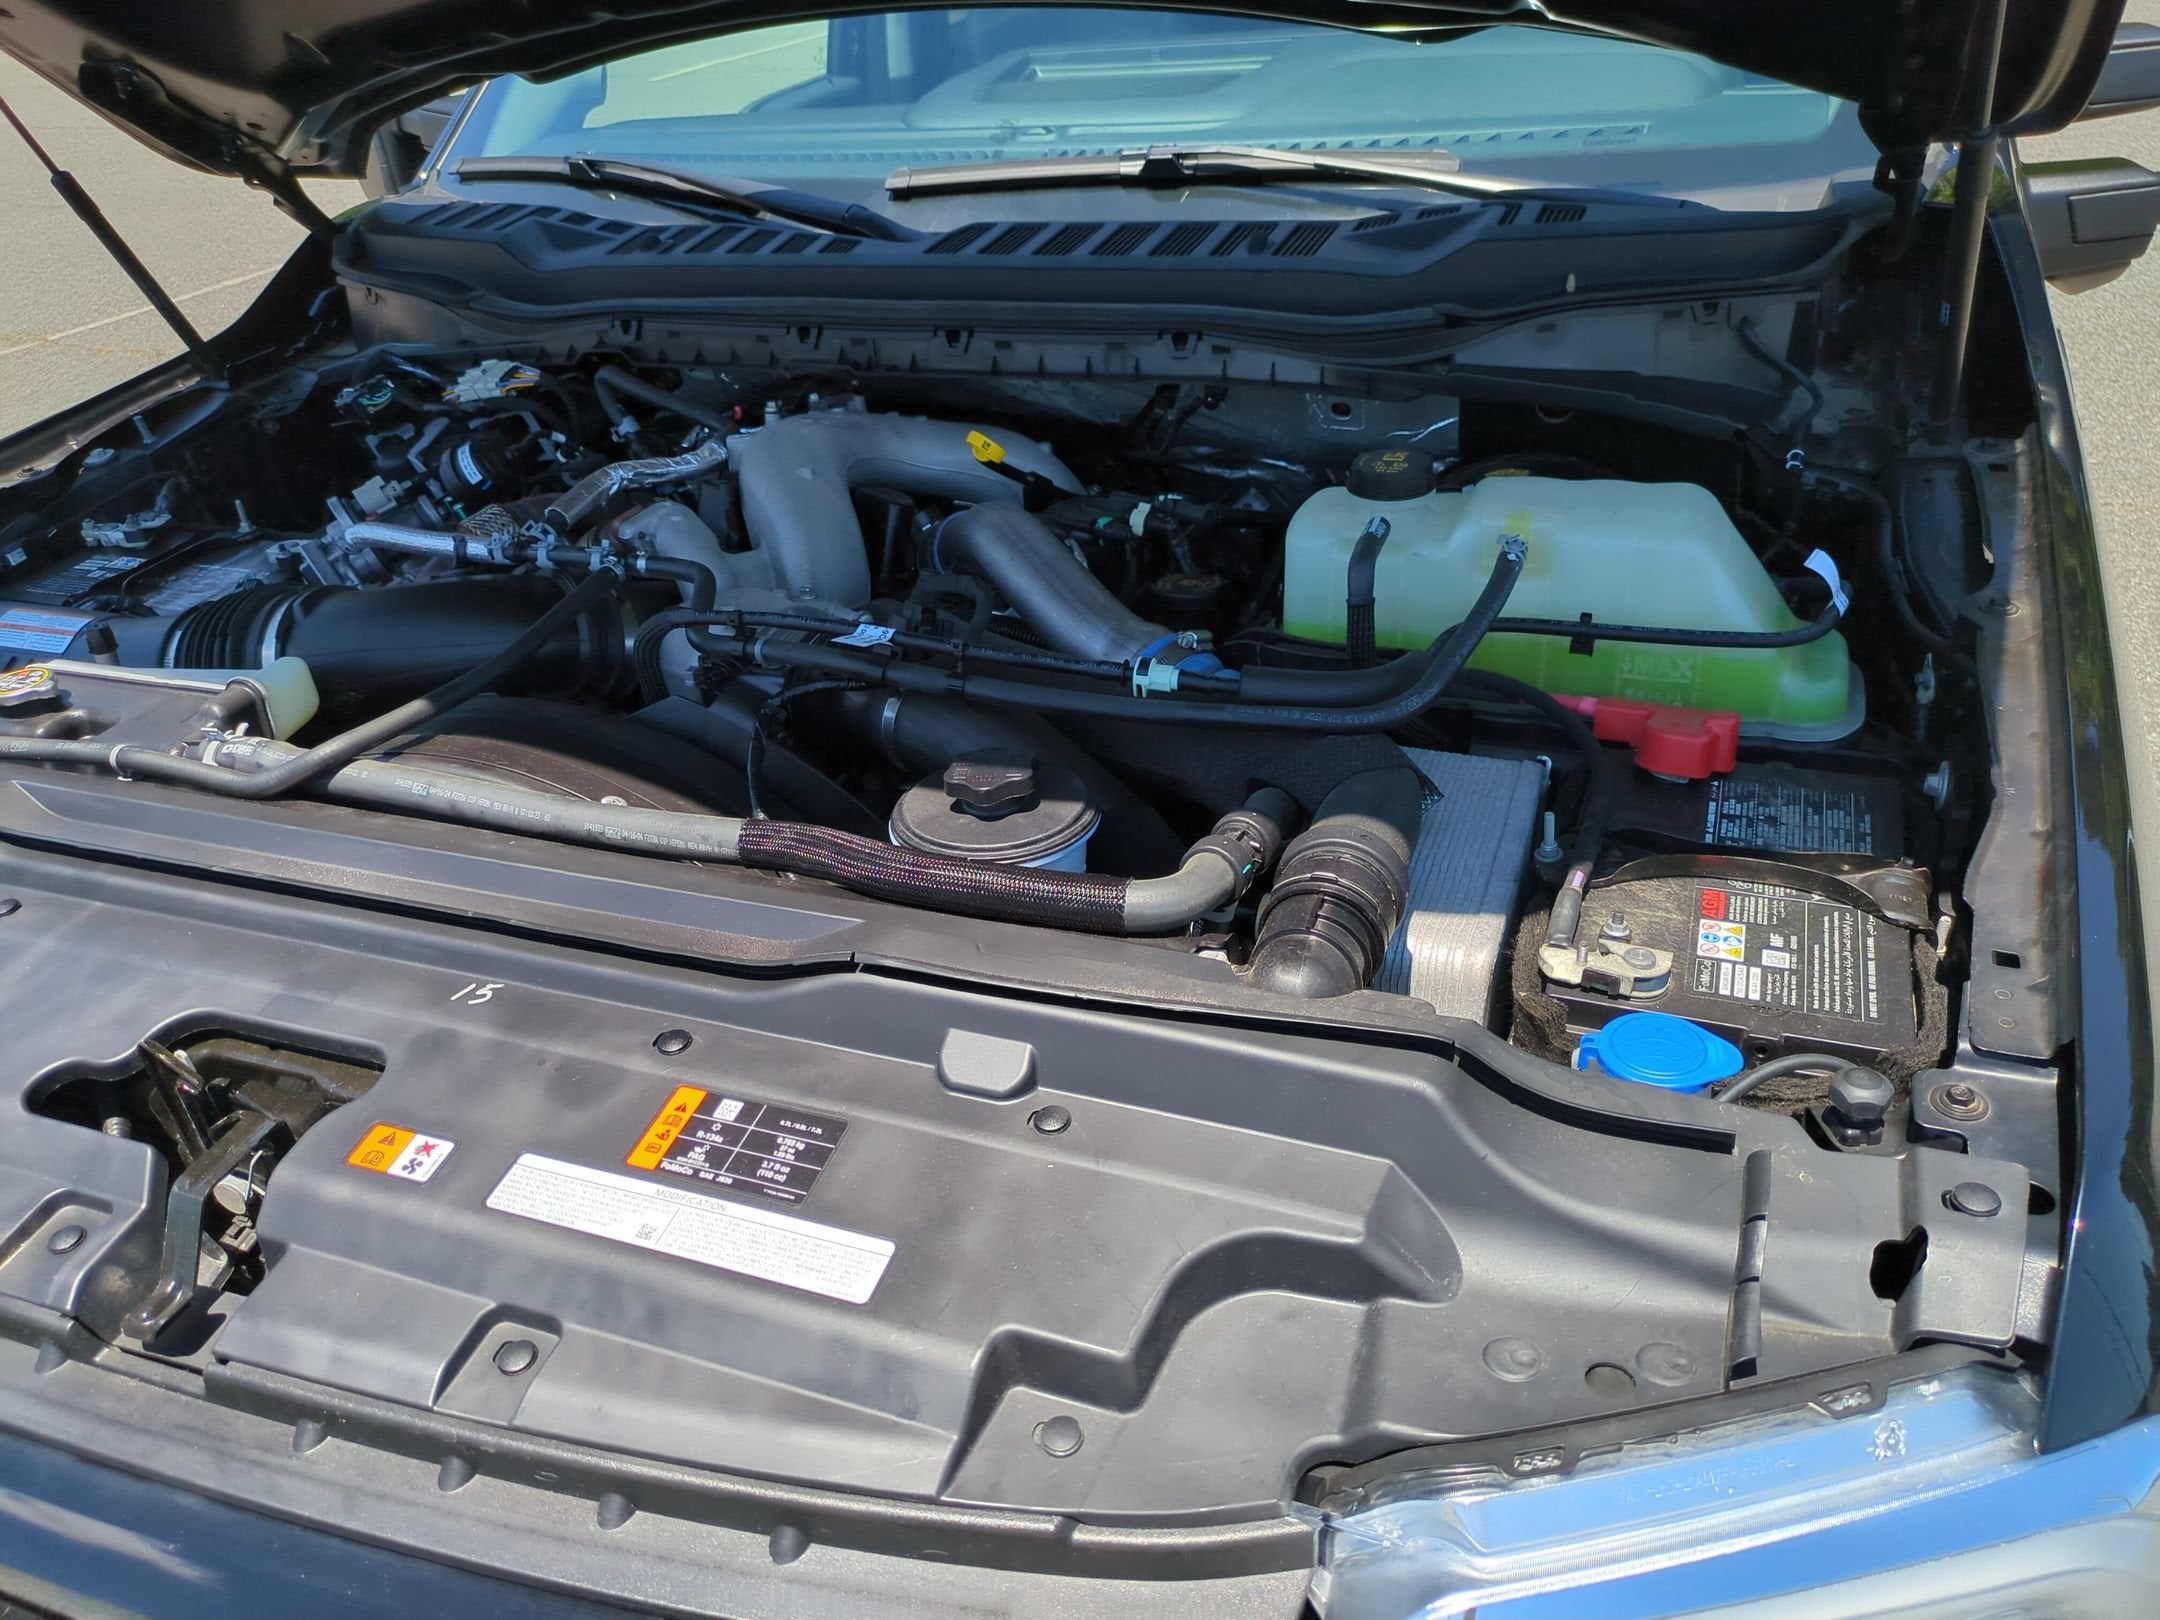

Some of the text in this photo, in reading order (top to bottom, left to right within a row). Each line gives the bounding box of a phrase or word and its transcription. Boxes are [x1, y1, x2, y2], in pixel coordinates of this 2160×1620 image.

[1632, 654, 1694, 678] MAX
[1701, 889, 1718, 918] AGM
[1769, 933, 1784, 947] MF
[1699, 960, 1712, 991] FoMoCo
[450, 983, 504, 1004] 15
[696, 1130, 723, 1143] R-134a
[795, 1141, 806, 1151] kg
[687, 1151, 706, 1162] PAG
[660, 1161, 694, 1176] FoMoCo
[699, 1171, 715, 1181] SAE
[756, 1168, 787, 1183] (110 cc)
[761, 1160, 775, 1169] 3.7
[780, 1166, 791, 1174] oz
[655, 1188, 727, 1212] MODIFICATION
